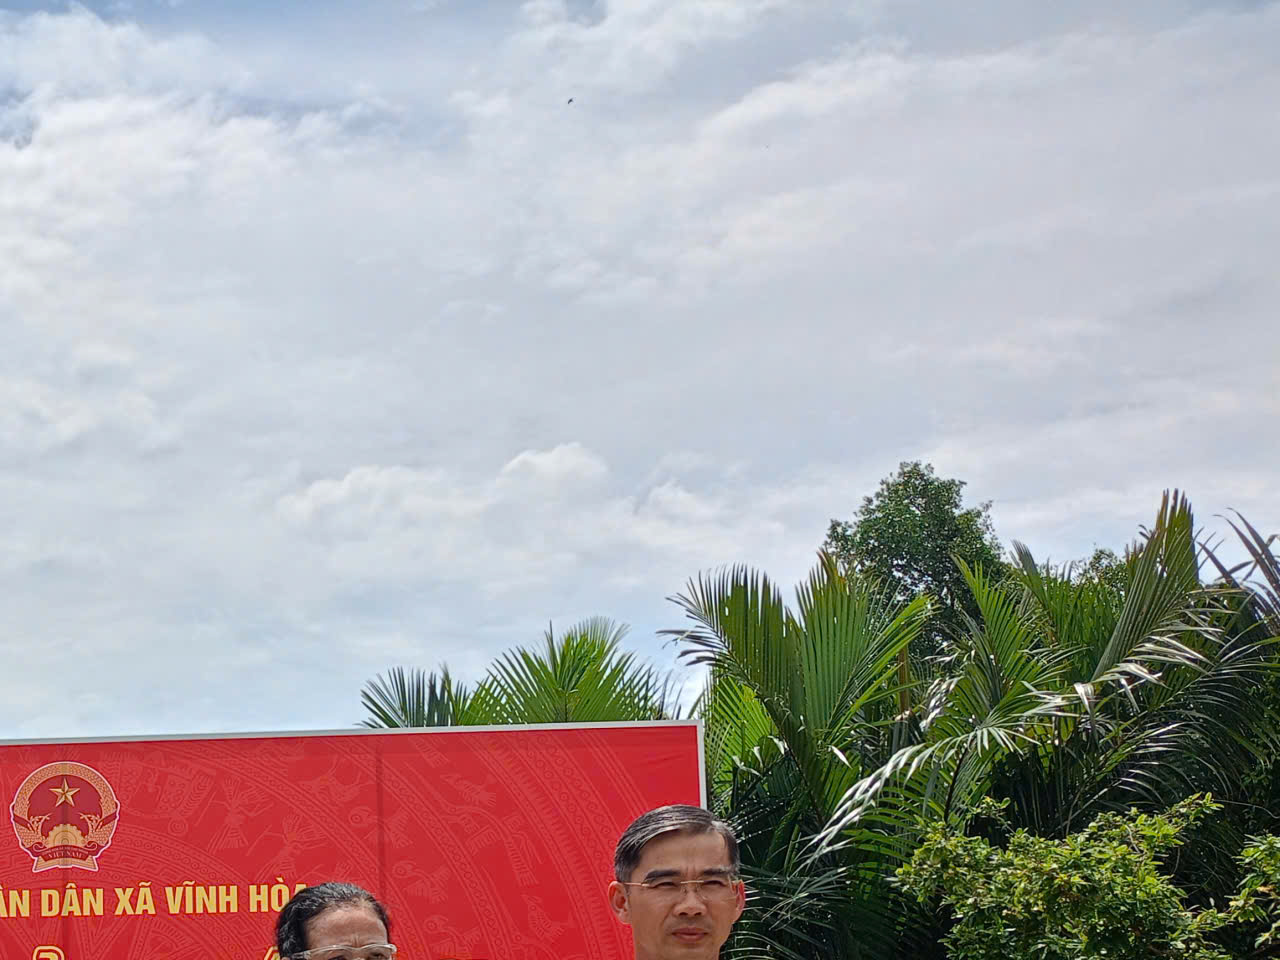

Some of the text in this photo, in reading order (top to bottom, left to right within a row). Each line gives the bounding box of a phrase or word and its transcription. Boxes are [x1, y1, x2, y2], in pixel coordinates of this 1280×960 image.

[40, 882, 104, 917] DÂN
[114, 881, 156, 915] XÃ
[165, 880, 238, 914] VĨNH
